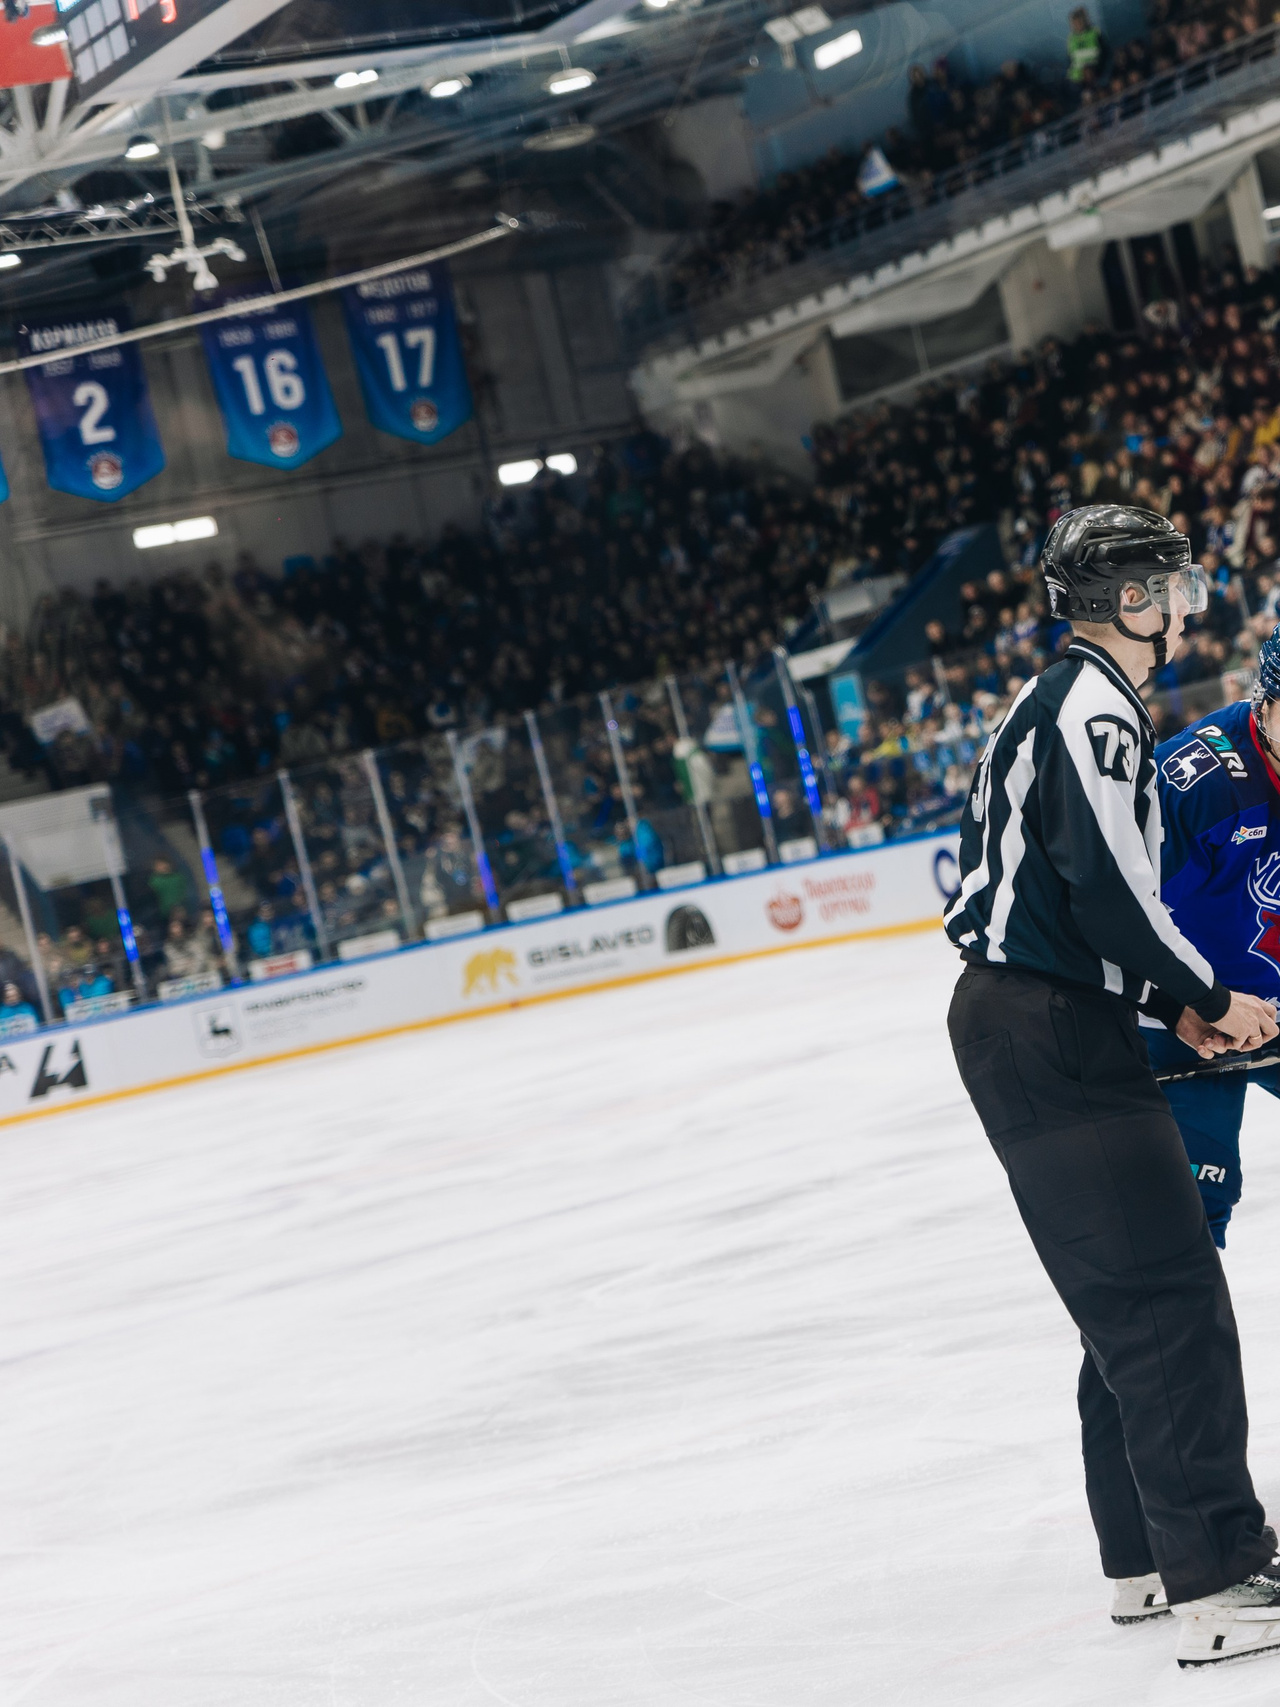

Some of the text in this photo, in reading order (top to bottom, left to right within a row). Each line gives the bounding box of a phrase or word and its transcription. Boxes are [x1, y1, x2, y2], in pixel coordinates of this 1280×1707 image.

[232, 349, 306, 416] 16
[376, 327, 436, 392] 17
[73, 381, 117, 445] 2
[1091, 721, 1136, 784] 73
[1195, 725, 1249, 778] PARI
[1248, 829, 1264, 838] сбп
[1190, 1164, 1226, 1183] RI
